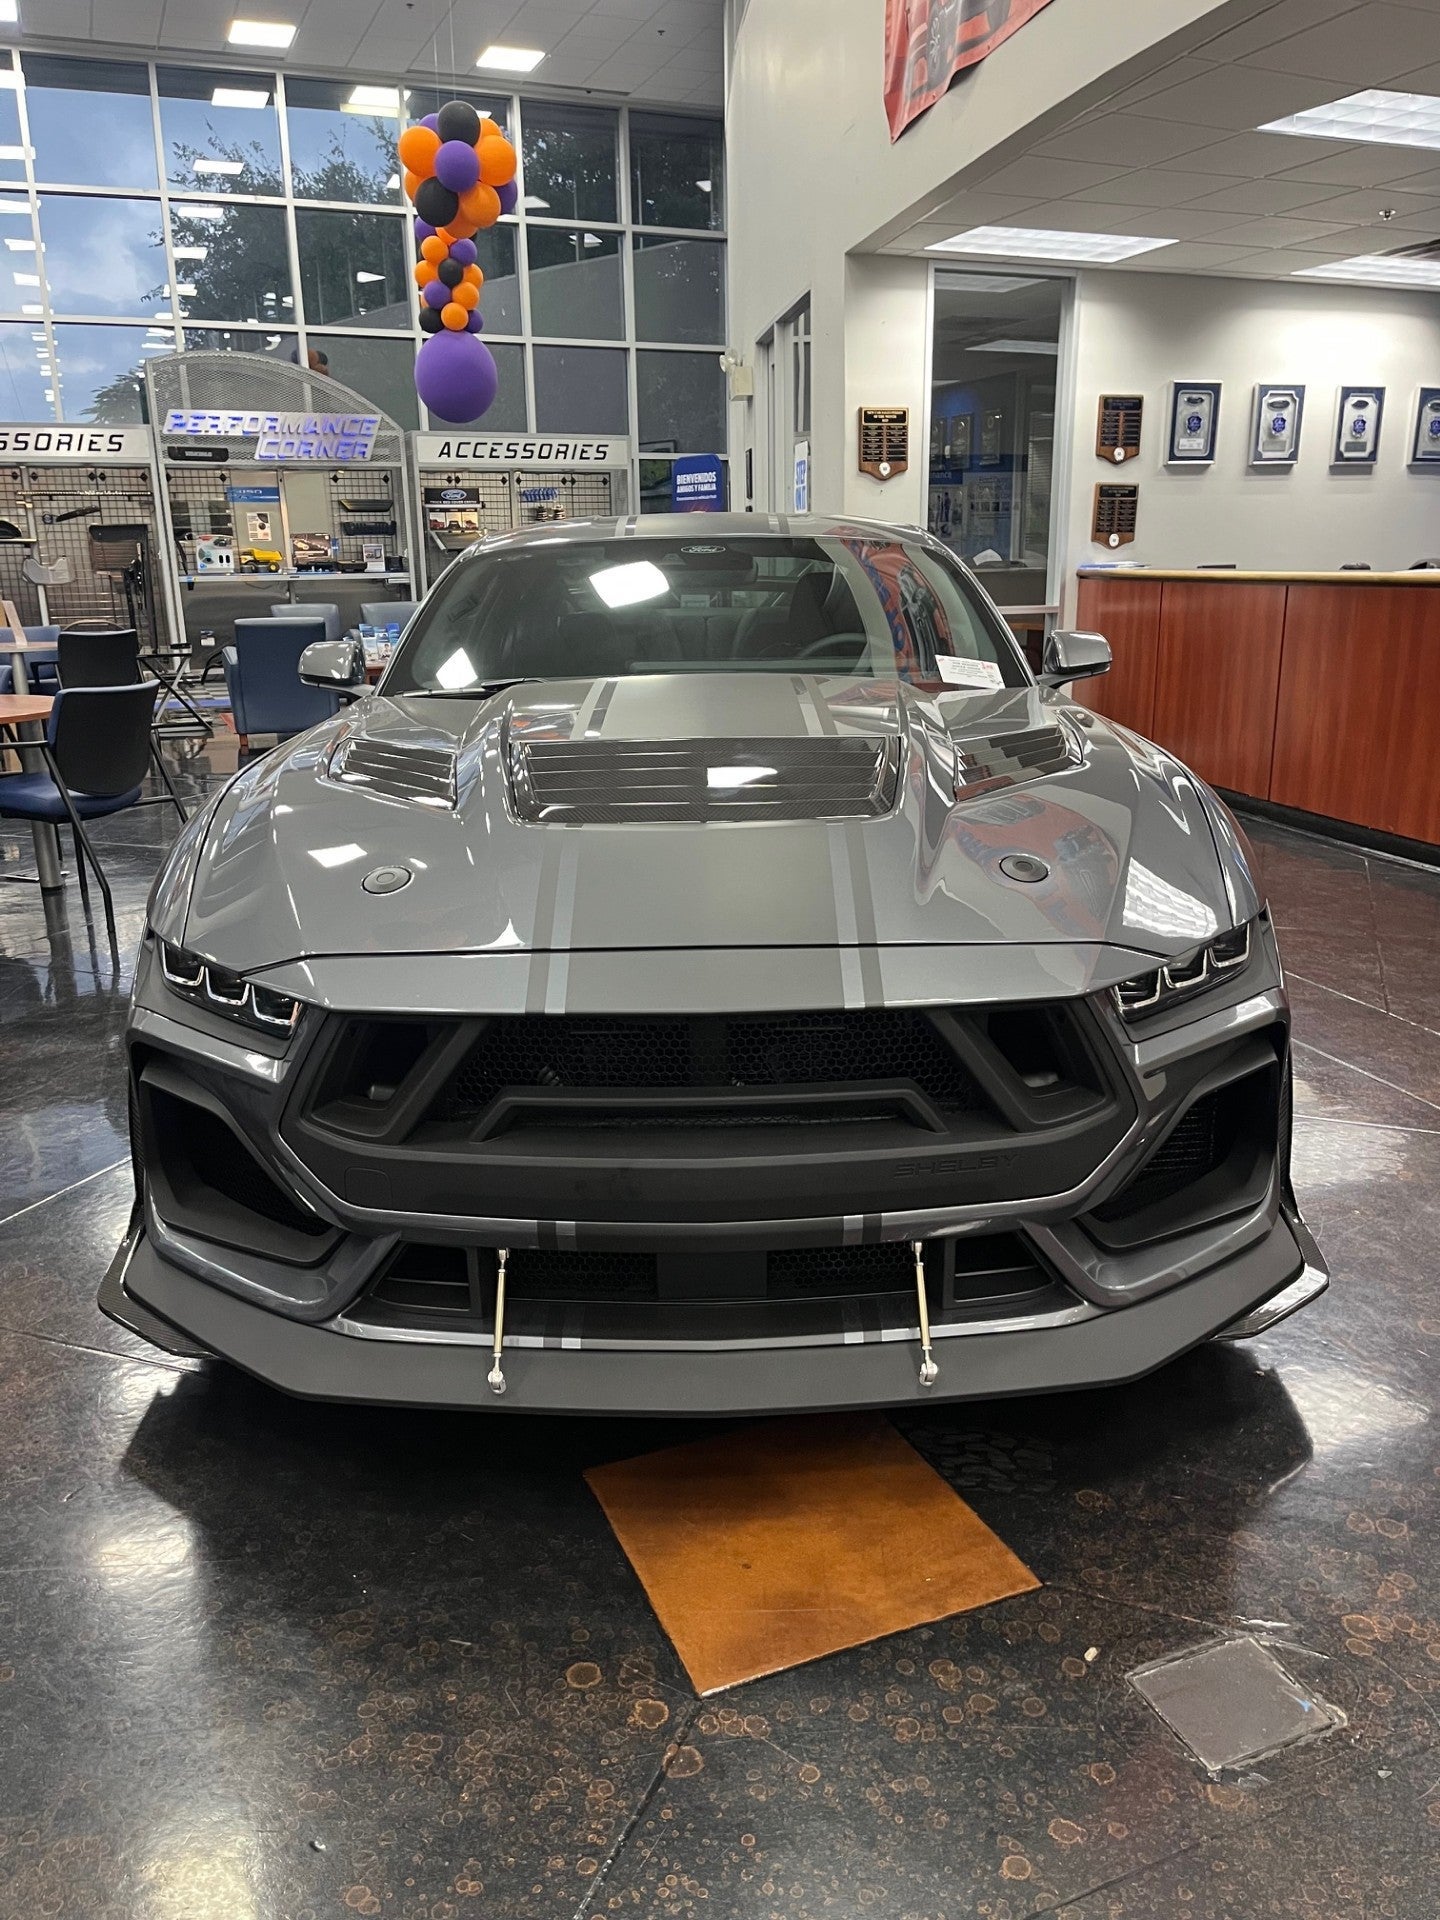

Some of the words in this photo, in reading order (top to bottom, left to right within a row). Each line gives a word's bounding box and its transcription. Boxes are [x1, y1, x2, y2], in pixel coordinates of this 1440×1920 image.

[166, 413, 379, 437] PERFORMANCE
[258, 441, 369, 460] CORNER
[438, 441, 609, 461] ACCESSORIES
[676, 471, 717, 485] BIENVENIDOS
[893, 1153, 1018, 1179] SHELBY
